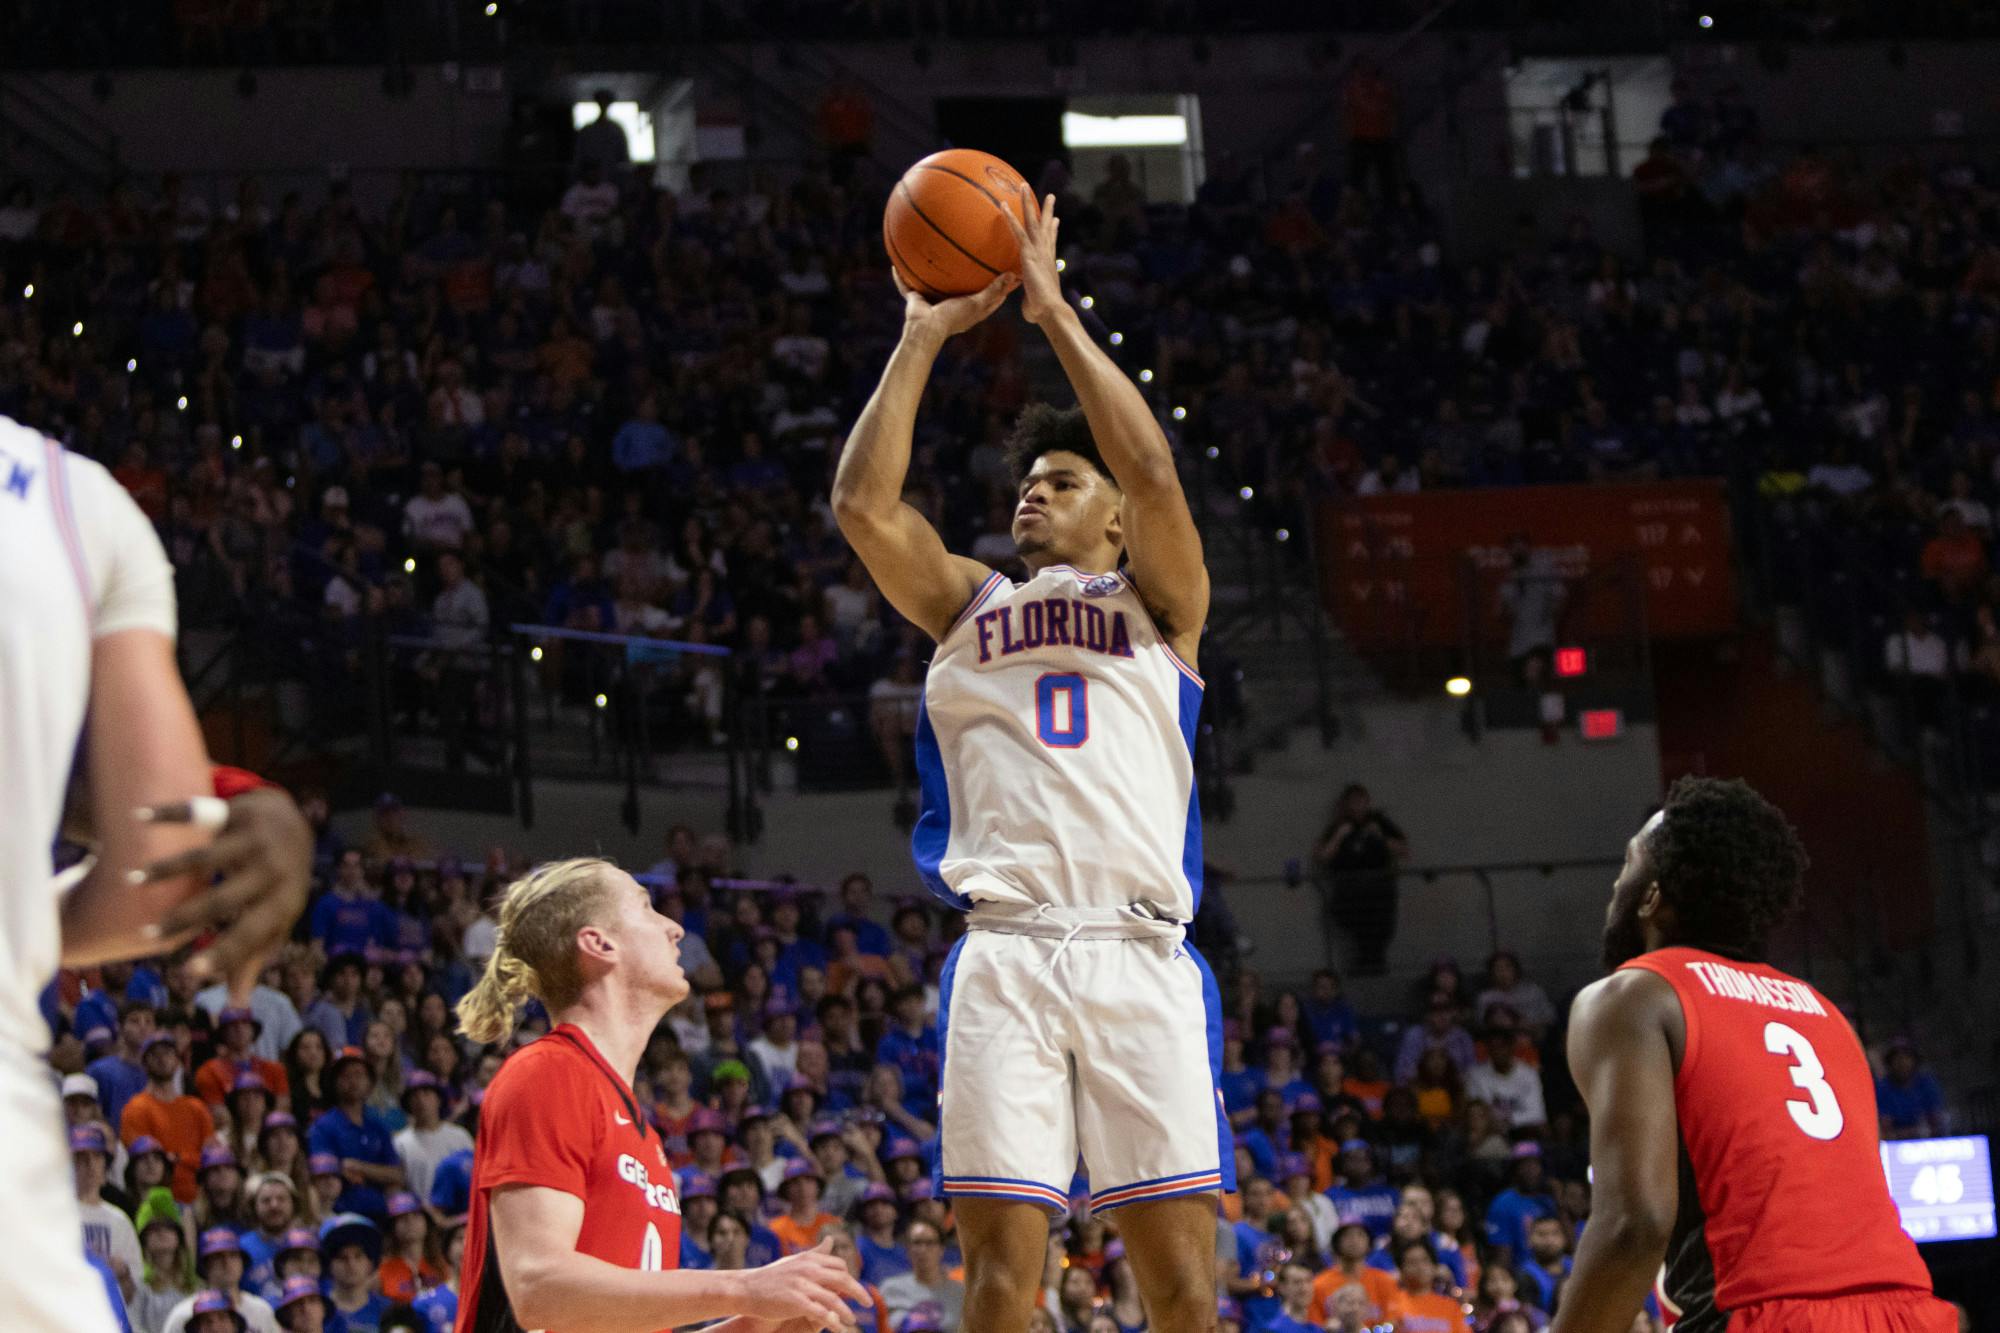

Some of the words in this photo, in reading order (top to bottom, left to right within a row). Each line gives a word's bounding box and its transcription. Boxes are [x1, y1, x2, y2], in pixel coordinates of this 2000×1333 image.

[975, 598, 1135, 664] FLORIDA
[1034, 671, 1090, 749] 0
[1684, 961, 1829, 1018] THOMASSON
[1763, 1020, 1845, 1141] 3
